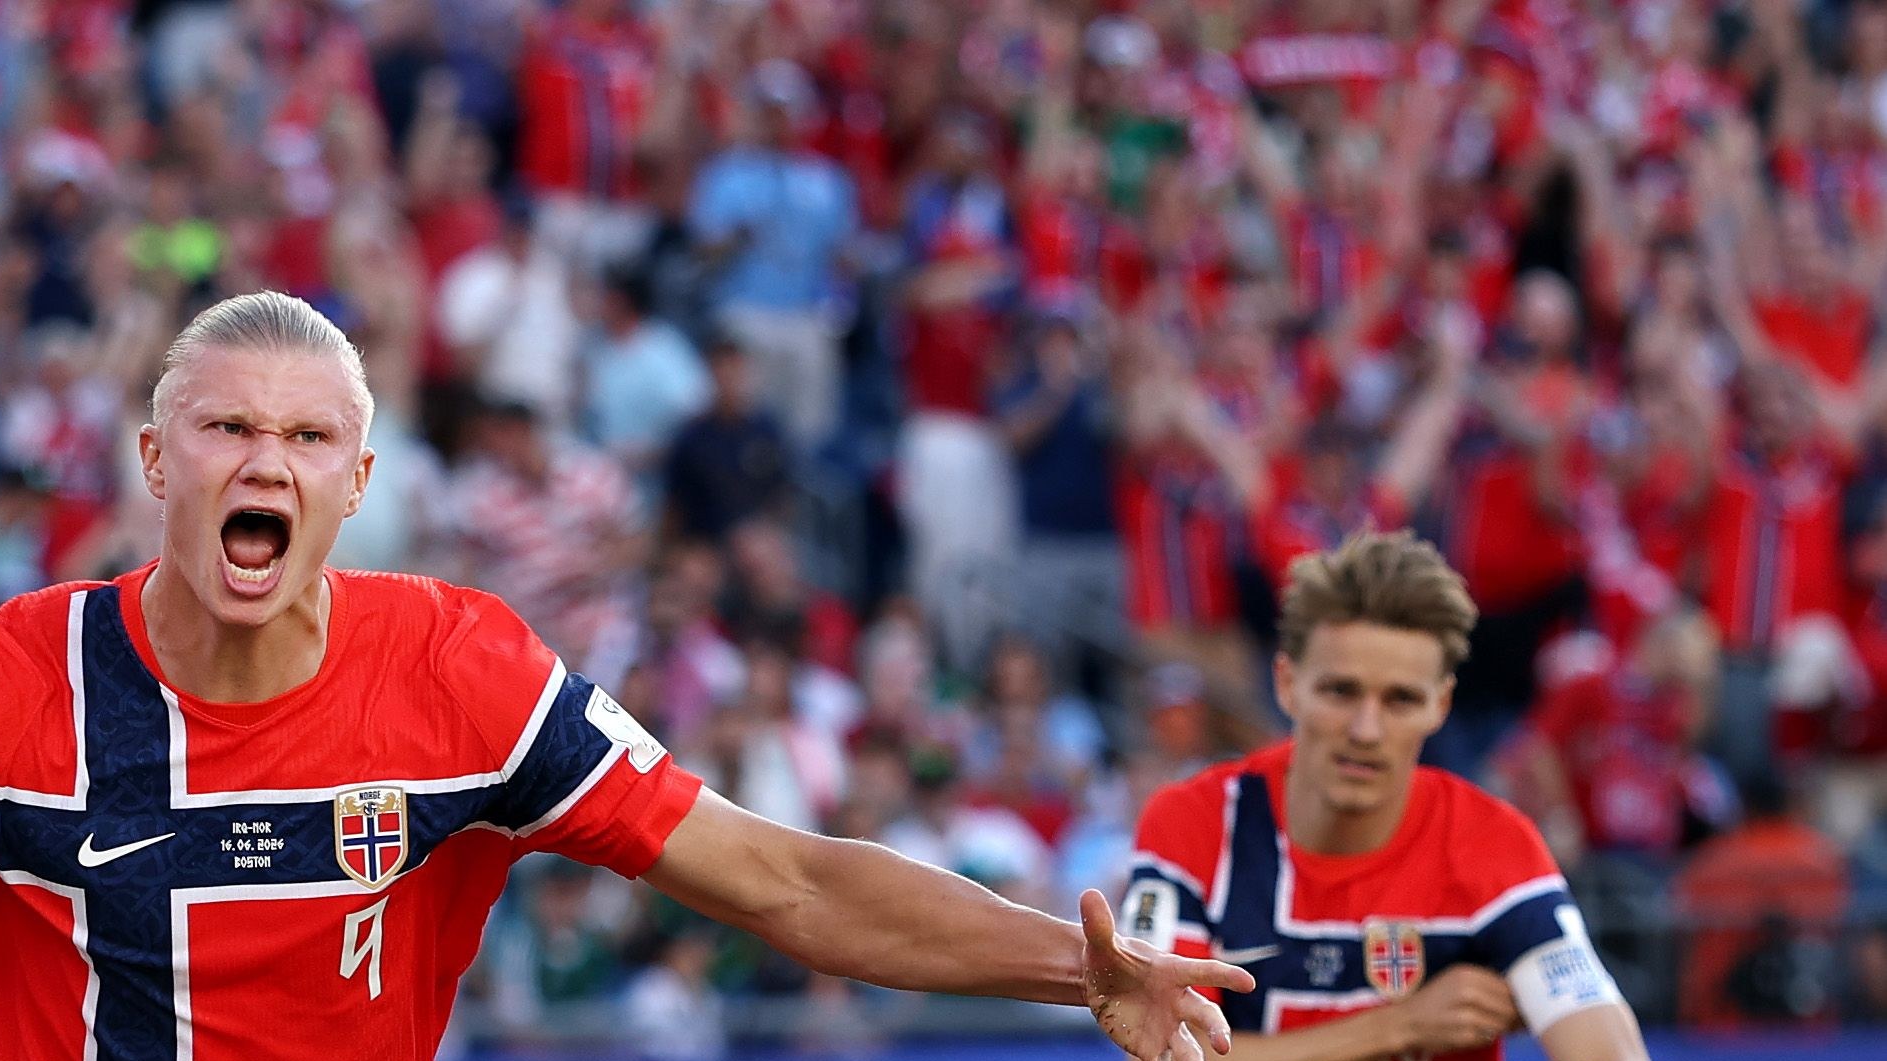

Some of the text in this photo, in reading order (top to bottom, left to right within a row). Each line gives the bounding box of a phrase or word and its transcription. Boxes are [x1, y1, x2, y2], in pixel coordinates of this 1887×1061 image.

[232, 822, 272, 834] IRQ-NOR
[234, 855, 271, 869] BOSTON
[339, 894, 390, 1001] 9
